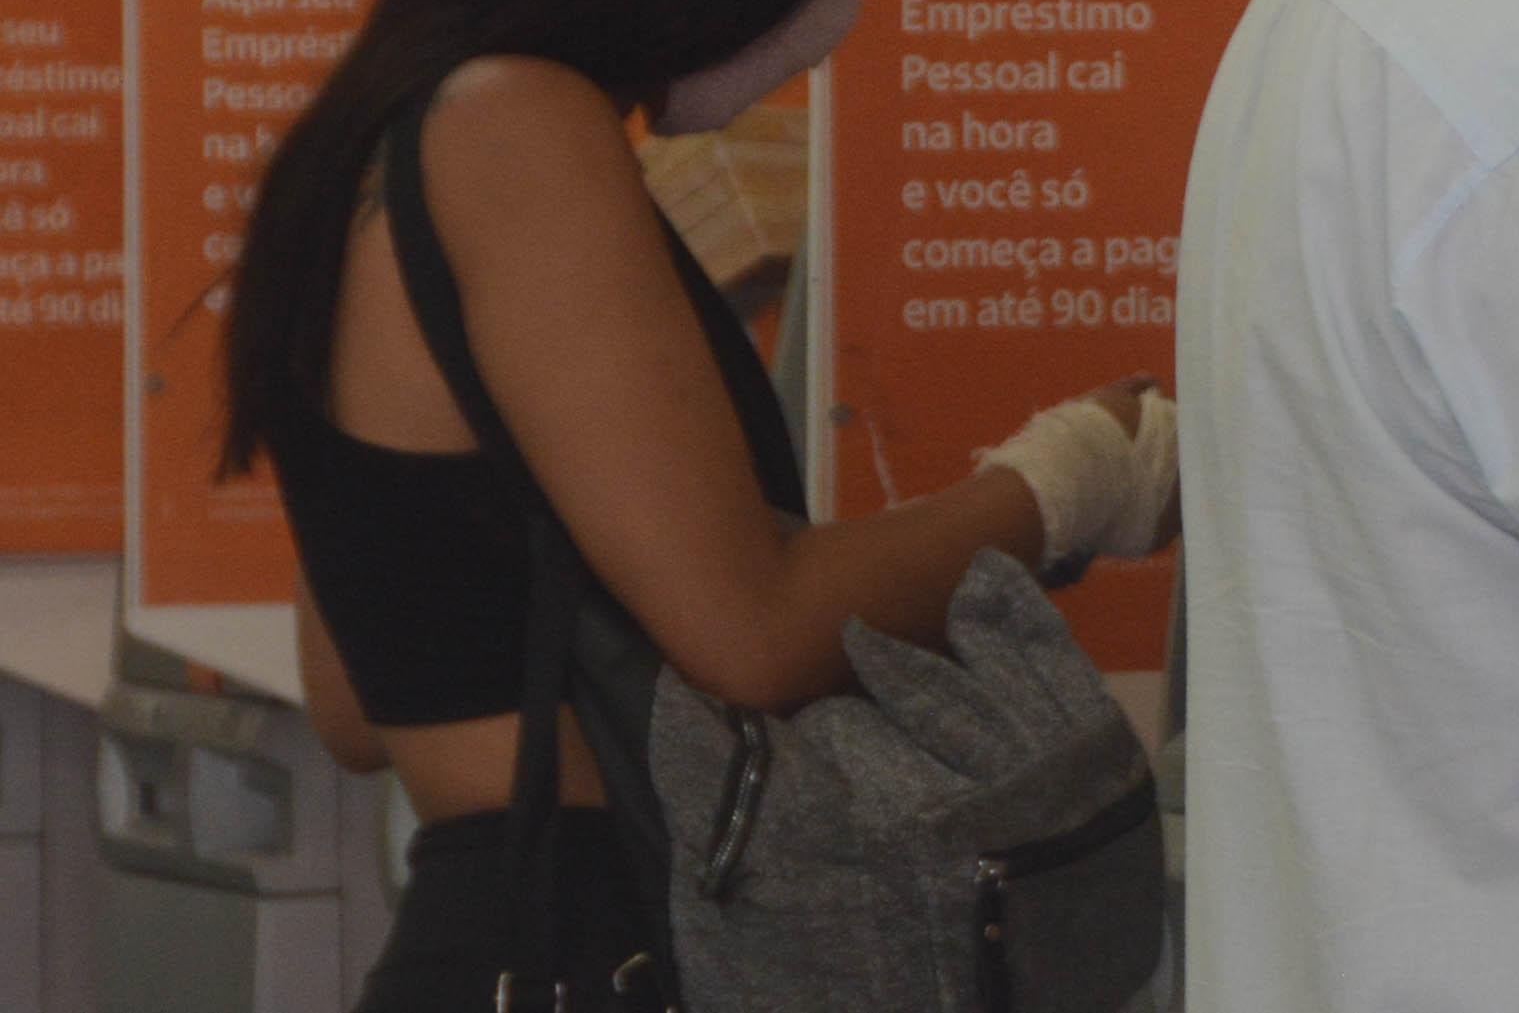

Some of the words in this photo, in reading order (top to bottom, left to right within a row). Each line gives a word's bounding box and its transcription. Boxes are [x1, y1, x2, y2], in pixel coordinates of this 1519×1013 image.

[903, 52, 1059, 91] Pessoal
[1067, 51, 1125, 90] cai
[903, 120, 953, 150] na
[963, 111, 1058, 150] hora
[903, 181, 925, 210] e
[935, 169, 1031, 210] você
[1041, 169, 1089, 210] só
[903, 236, 1062, 278] começa
[1072, 237, 1095, 267] a
[903, 297, 966, 328] em
[976, 286, 1042, 327] até
[1050, 290, 1102, 326] 90
